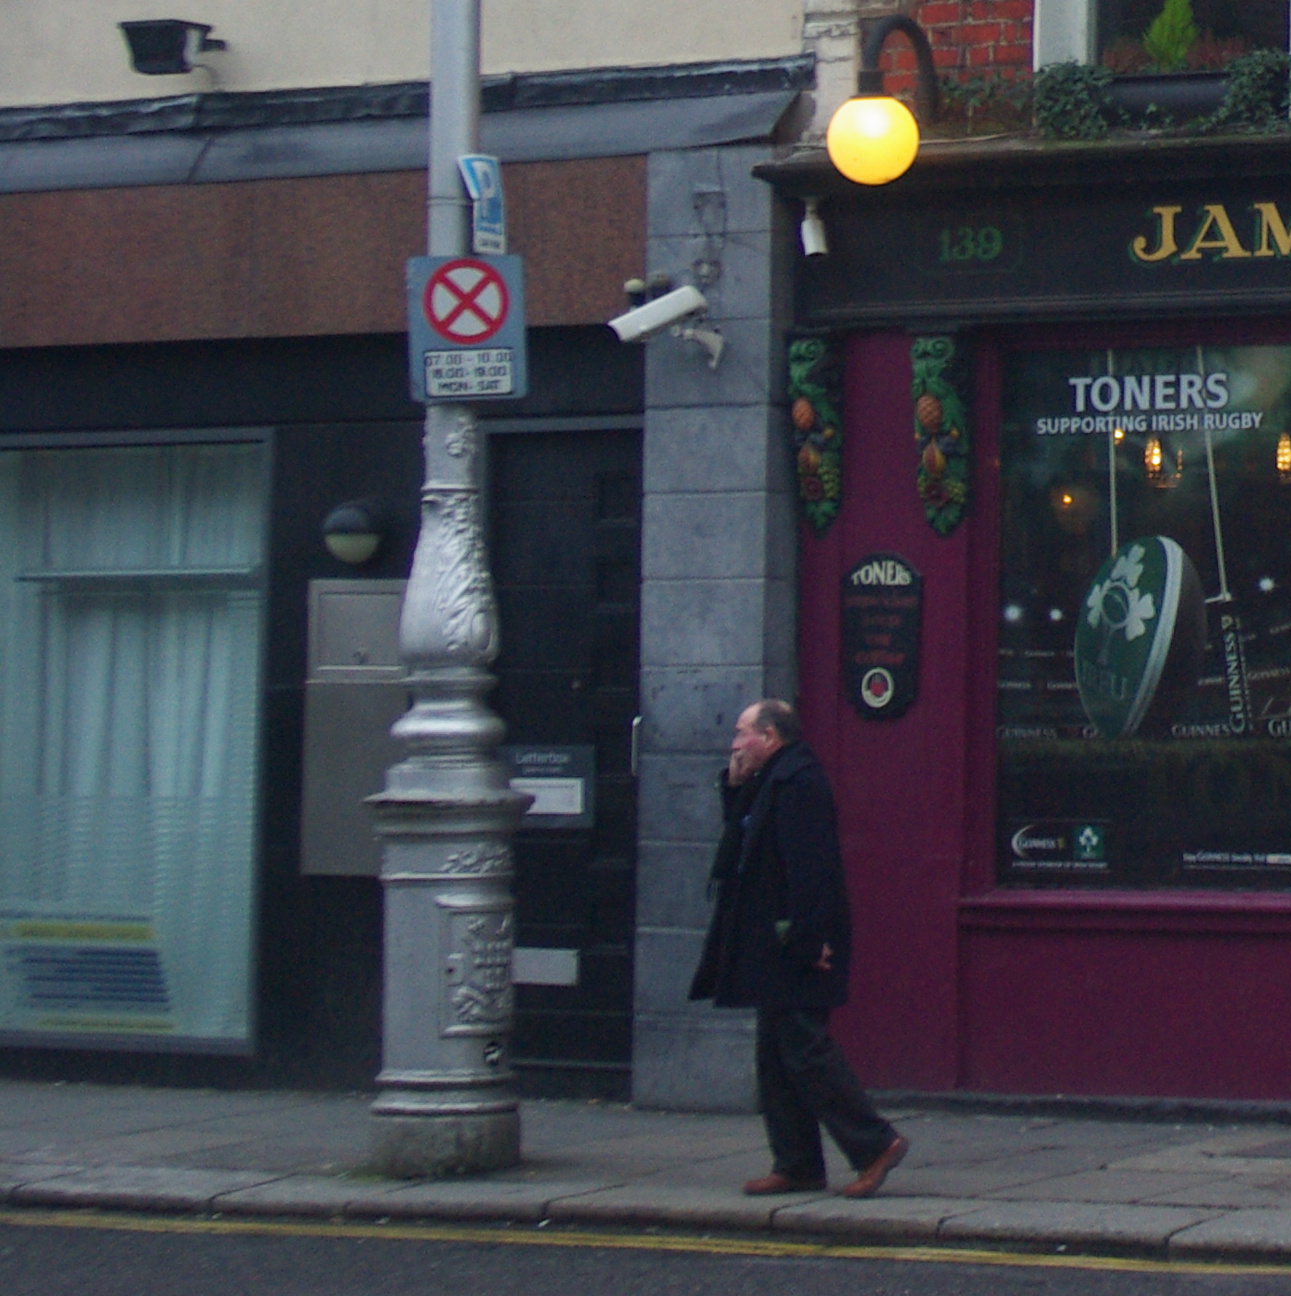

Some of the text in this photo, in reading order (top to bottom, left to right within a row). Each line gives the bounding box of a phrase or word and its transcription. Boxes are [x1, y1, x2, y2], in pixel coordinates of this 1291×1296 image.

[938, 225, 1003, 265] 139
[1069, 372, 1229, 412] TONERS
[1036, 412, 1263, 435] SUPPORTING IRISH RUGBY
[1222, 631, 1246, 733] GUINNESS
[1171, 723, 1231, 738] GUINNES
